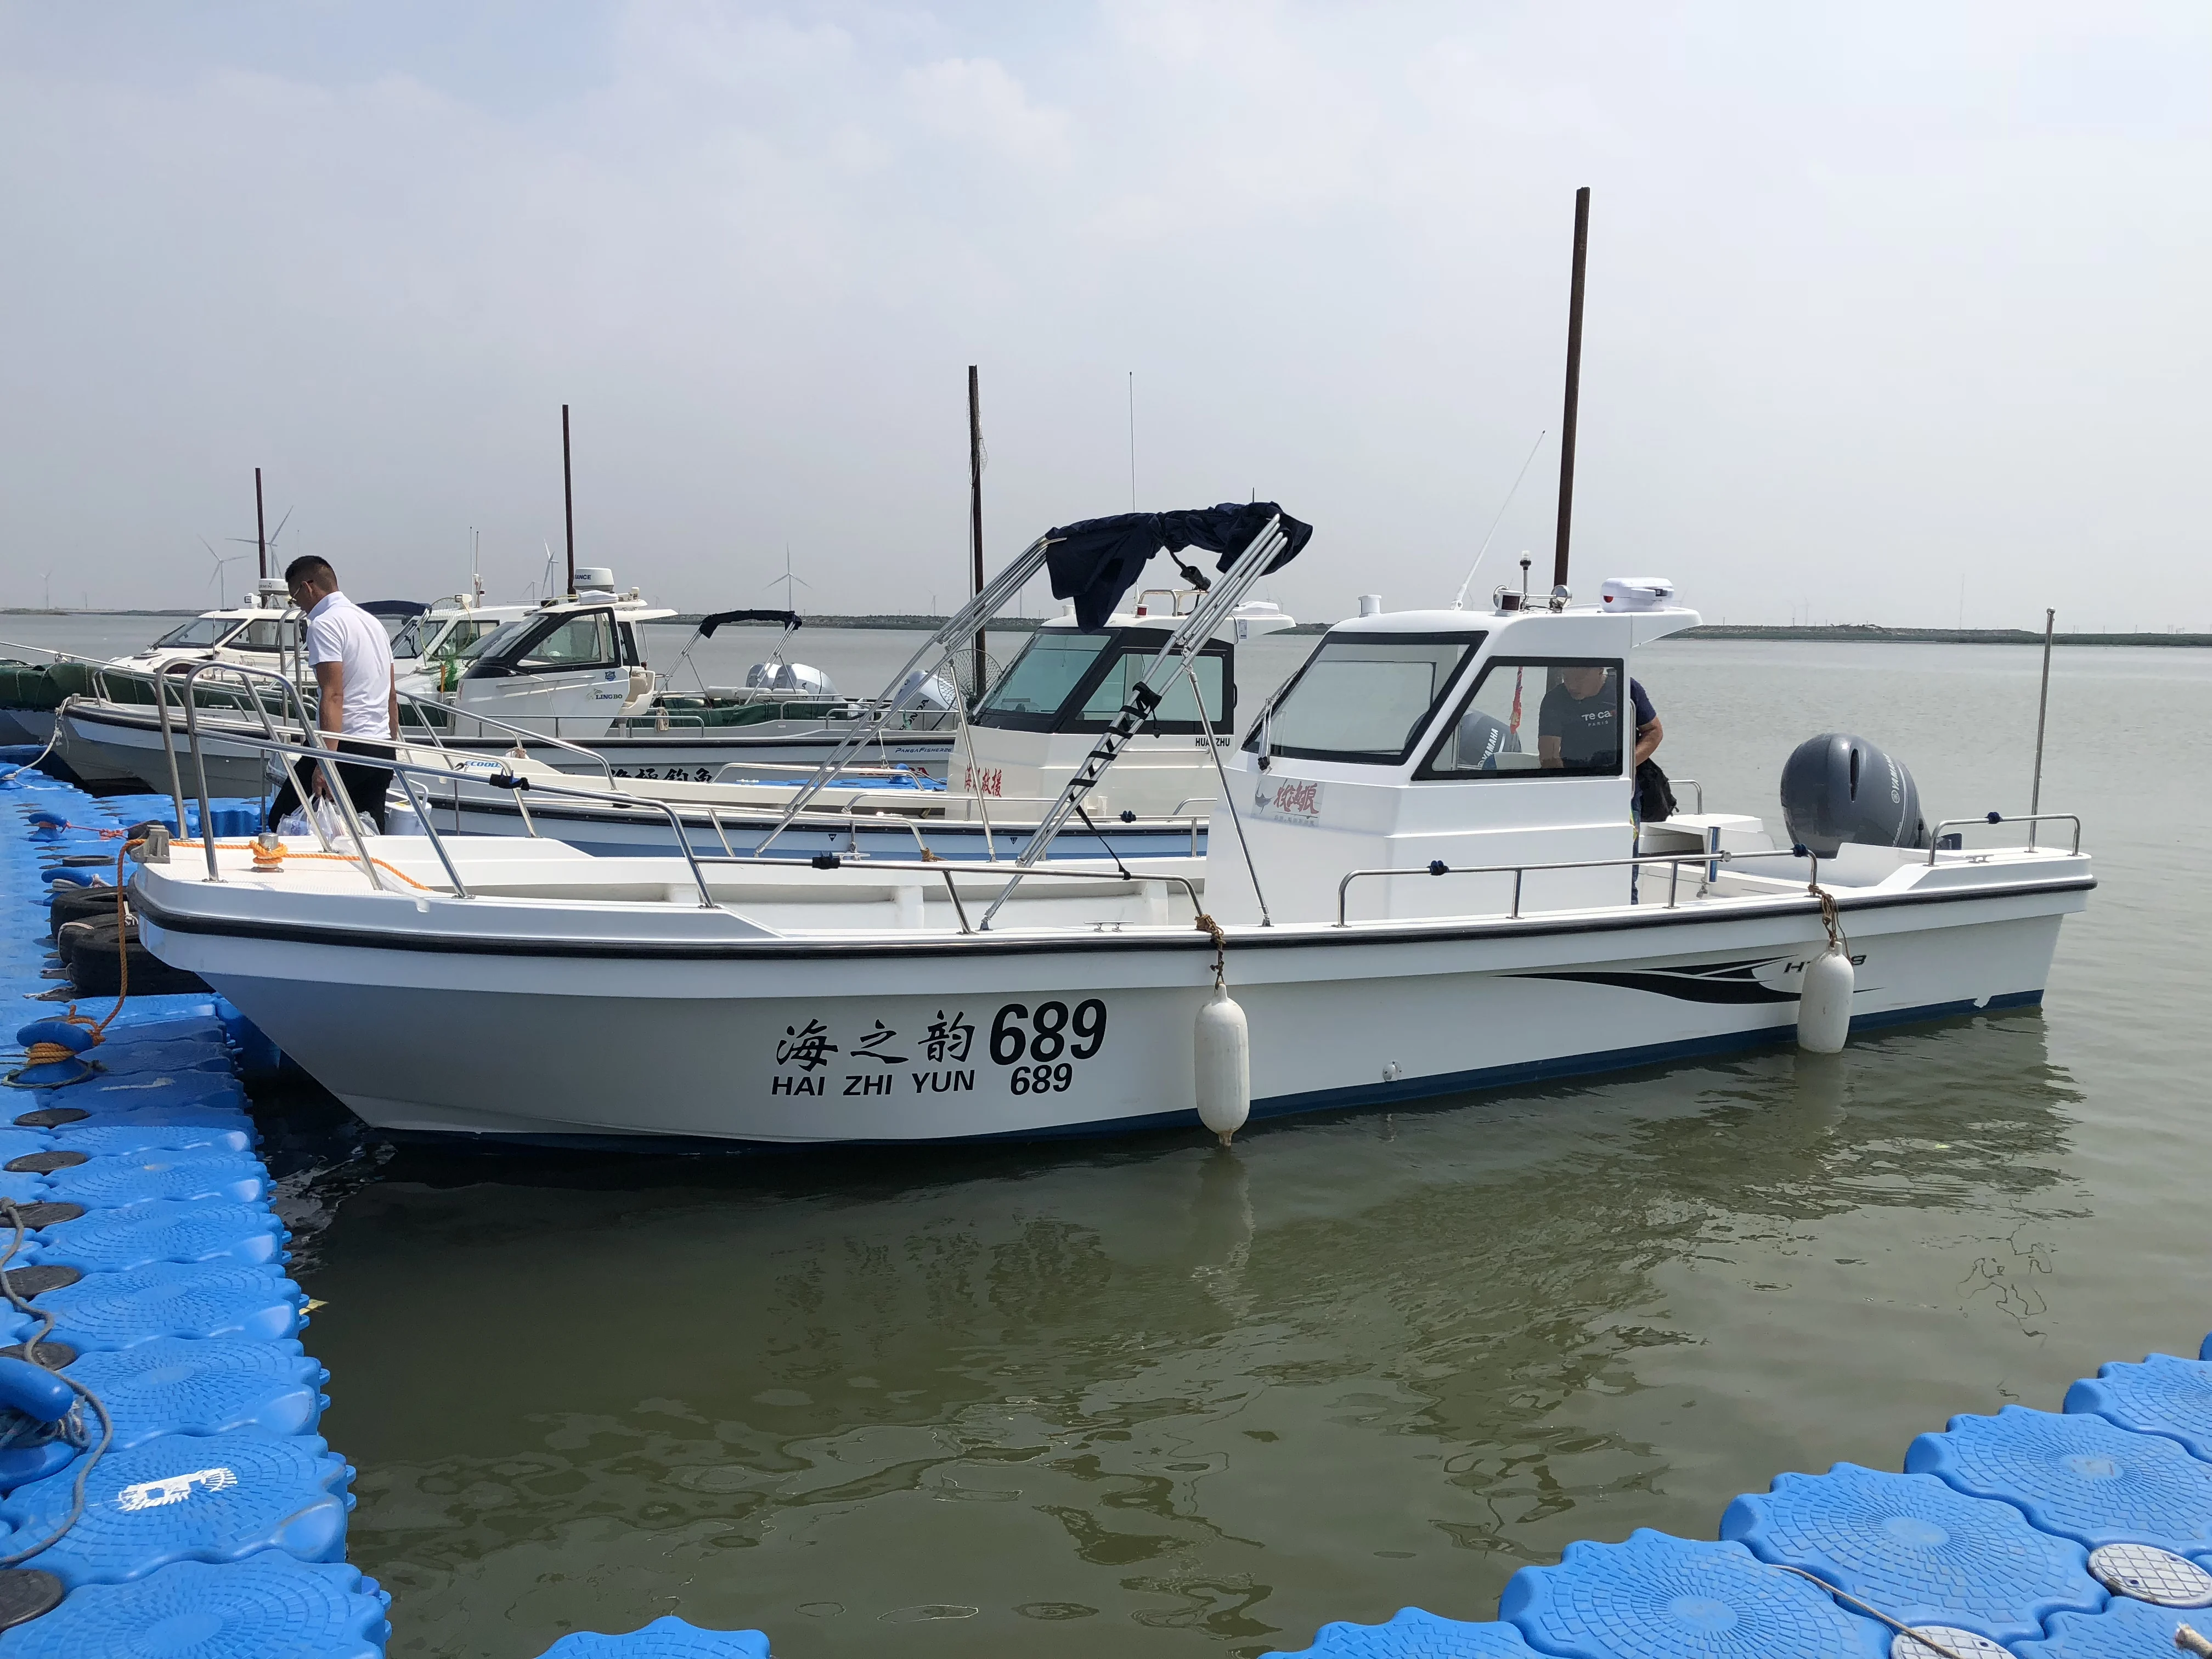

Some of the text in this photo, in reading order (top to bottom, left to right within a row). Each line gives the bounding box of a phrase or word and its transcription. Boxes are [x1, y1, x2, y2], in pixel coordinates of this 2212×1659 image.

[1481, 727, 1499, 761] YAMAHA
[1883, 753, 1900, 791] YAMAHA
[776, 998, 1107, 1072] 海之韵 689
[771, 1063, 1073, 1097] HAI ZHI YUN 689
